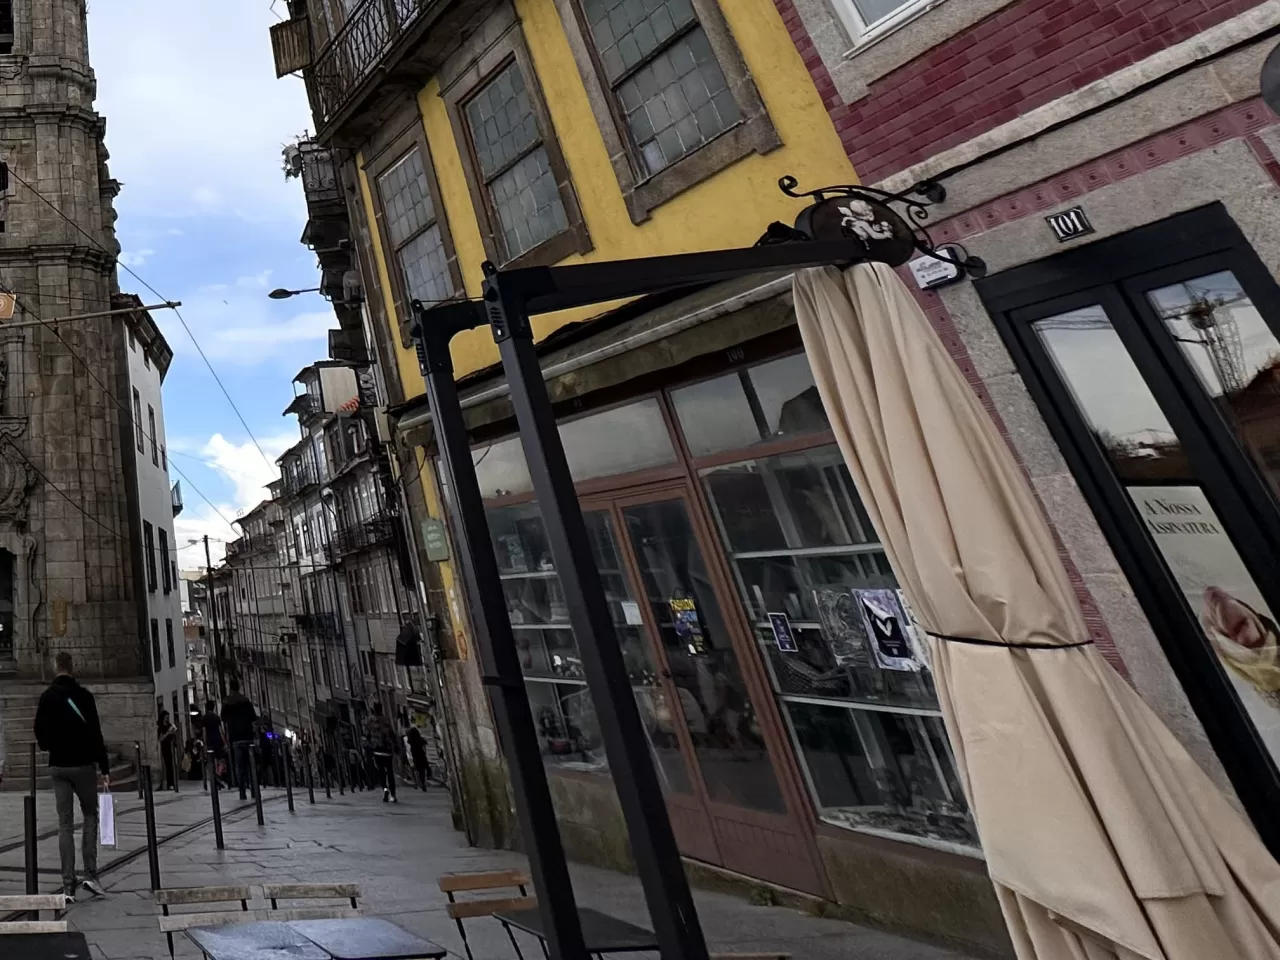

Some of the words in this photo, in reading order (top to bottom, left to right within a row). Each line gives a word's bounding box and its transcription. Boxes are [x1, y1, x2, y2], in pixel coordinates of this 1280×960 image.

[1050, 211, 1084, 237] 101
[1144, 500, 1158, 515] A
[1147, 519, 1220, 535] ASSINATURA
